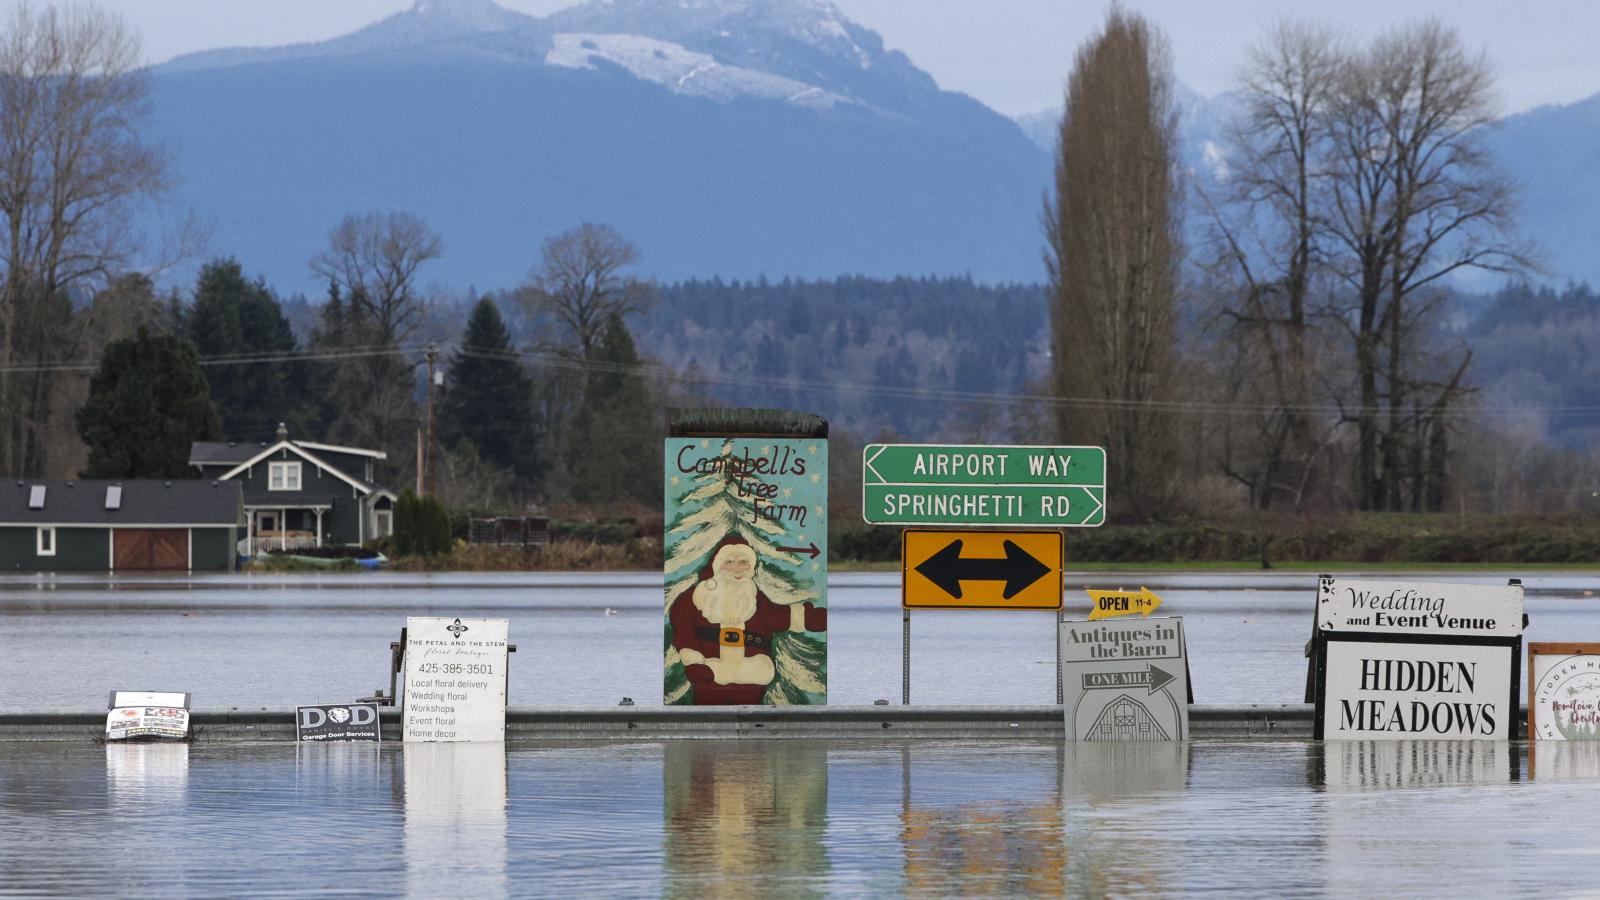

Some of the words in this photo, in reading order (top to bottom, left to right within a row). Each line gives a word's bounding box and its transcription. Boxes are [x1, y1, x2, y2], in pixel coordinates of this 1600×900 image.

[677, 444, 806, 484] Campbell's
[913, 454, 1009, 476] AIRPORT
[1028, 455, 1072, 477] WAY
[751, 498, 807, 528] Farm
[883, 494, 1023, 517] SPRINGHETTI
[1041, 495, 1070, 517] RD
[1099, 596, 1129, 611] OPEN
[1135, 599, 1152, 607] 11-4
[1345, 587, 1445, 618] Wedding
[1346, 616, 1370, 626] and
[1375, 612, 1428, 628] Event
[1436, 613, 1496, 630] Venue
[1067, 626, 1152, 646] Antiques
[1155, 624, 1175, 640] in
[1090, 644, 1118, 659] the
[1122, 643, 1167, 657] Barn
[418, 663, 494, 675] 425-385-3501
[1359, 658, 1477, 694] HIDDEN
[411, 679, 433, 688] Local
[435, 679, 455, 688] floral
[457, 680, 488, 690] delivery
[1091, 673, 1120, 686] ONE
[1121, 672, 1154, 684] MILE
[1540, 664, 1577, 704] HIDDEN
[411, 691, 444, 701] Wedding
[447, 692, 468, 700] floral
[410, 704, 455, 714] Workshops
[1339, 699, 1496, 736] MEADOWS
[409, 716, 432, 725] Event
[435, 717, 456, 725] floral
[302, 733, 327, 741] Garage
[409, 729, 433, 738] Home
[434, 730, 457, 738] decor
